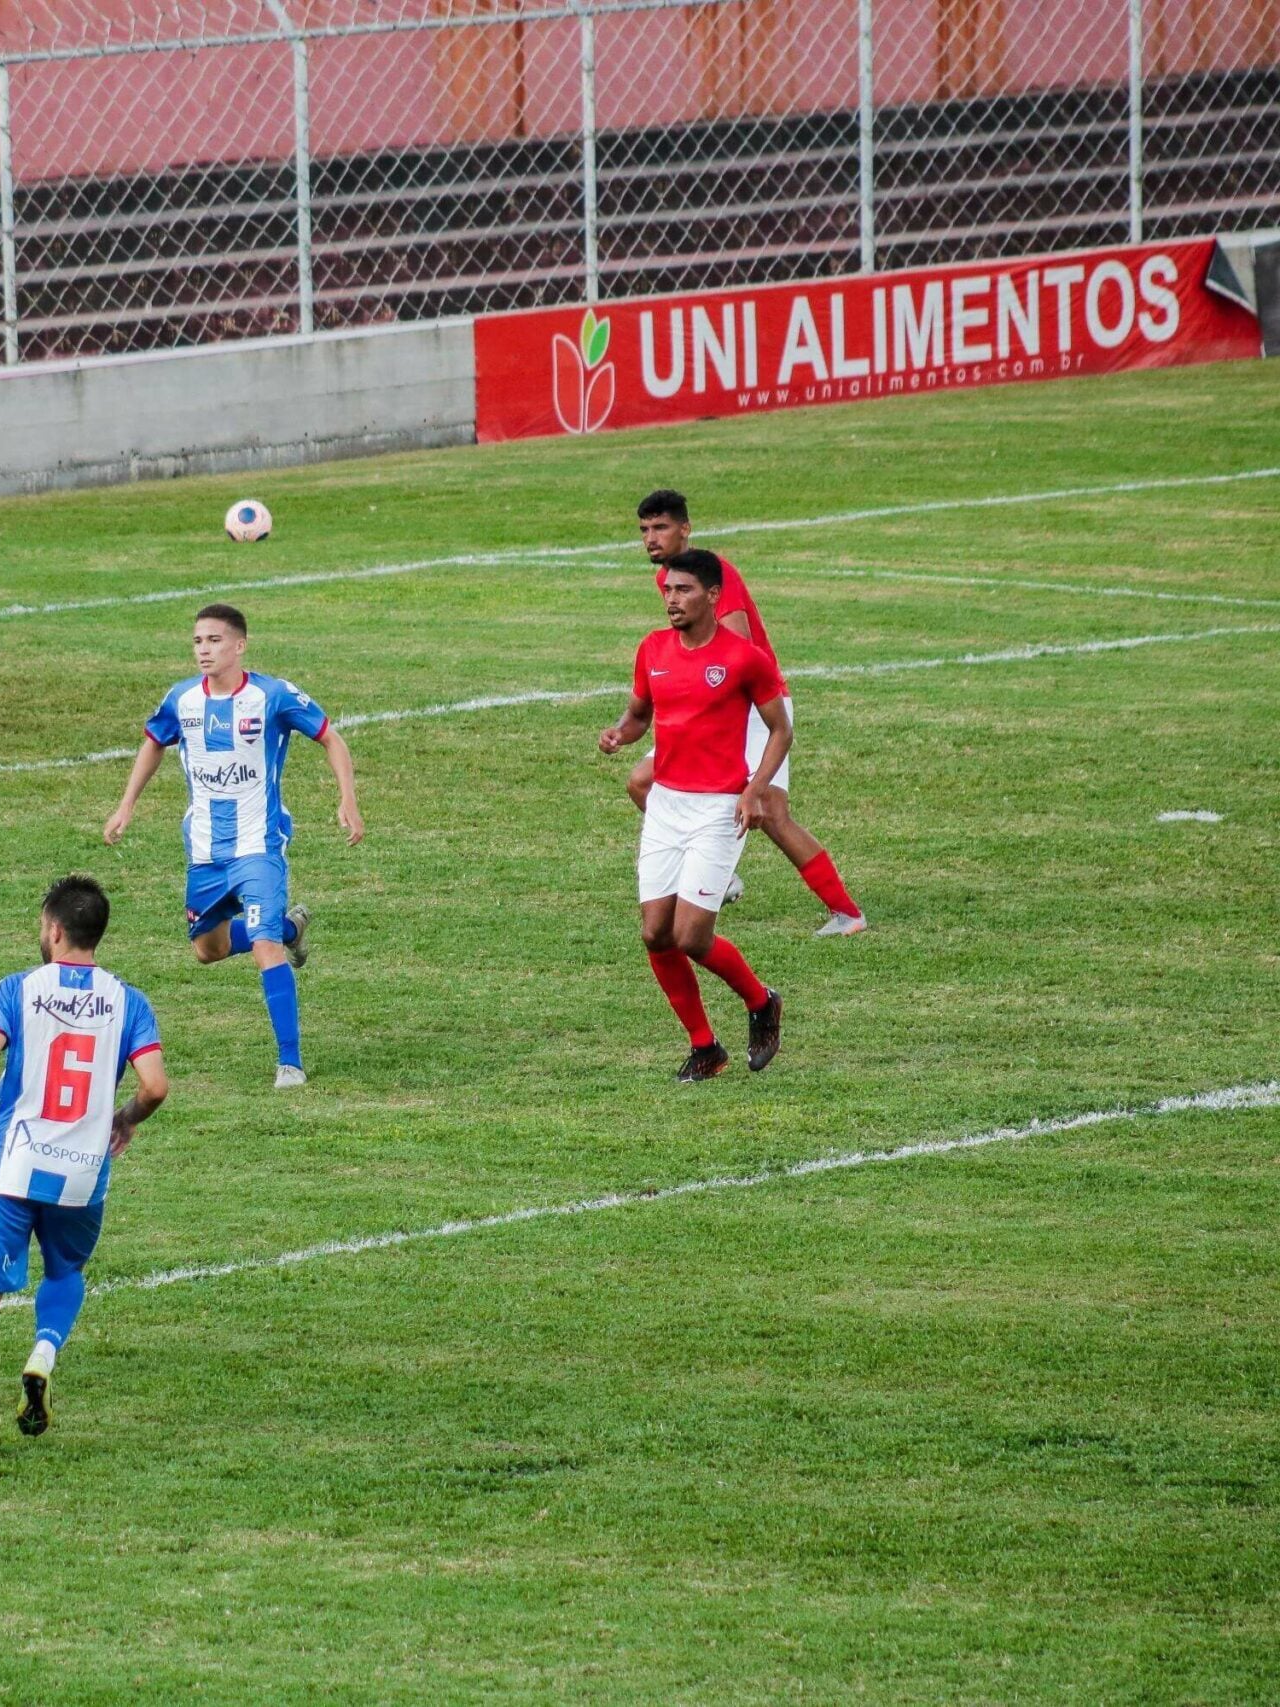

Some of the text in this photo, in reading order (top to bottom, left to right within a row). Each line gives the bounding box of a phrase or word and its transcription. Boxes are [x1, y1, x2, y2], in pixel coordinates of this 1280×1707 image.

[639, 253, 1182, 398] UNI ALIMENTOS
[737, 350, 1085, 408] www.unialimentos.com.br
[247, 904, 261, 928] 8
[40, 1032, 97, 1123] 6
